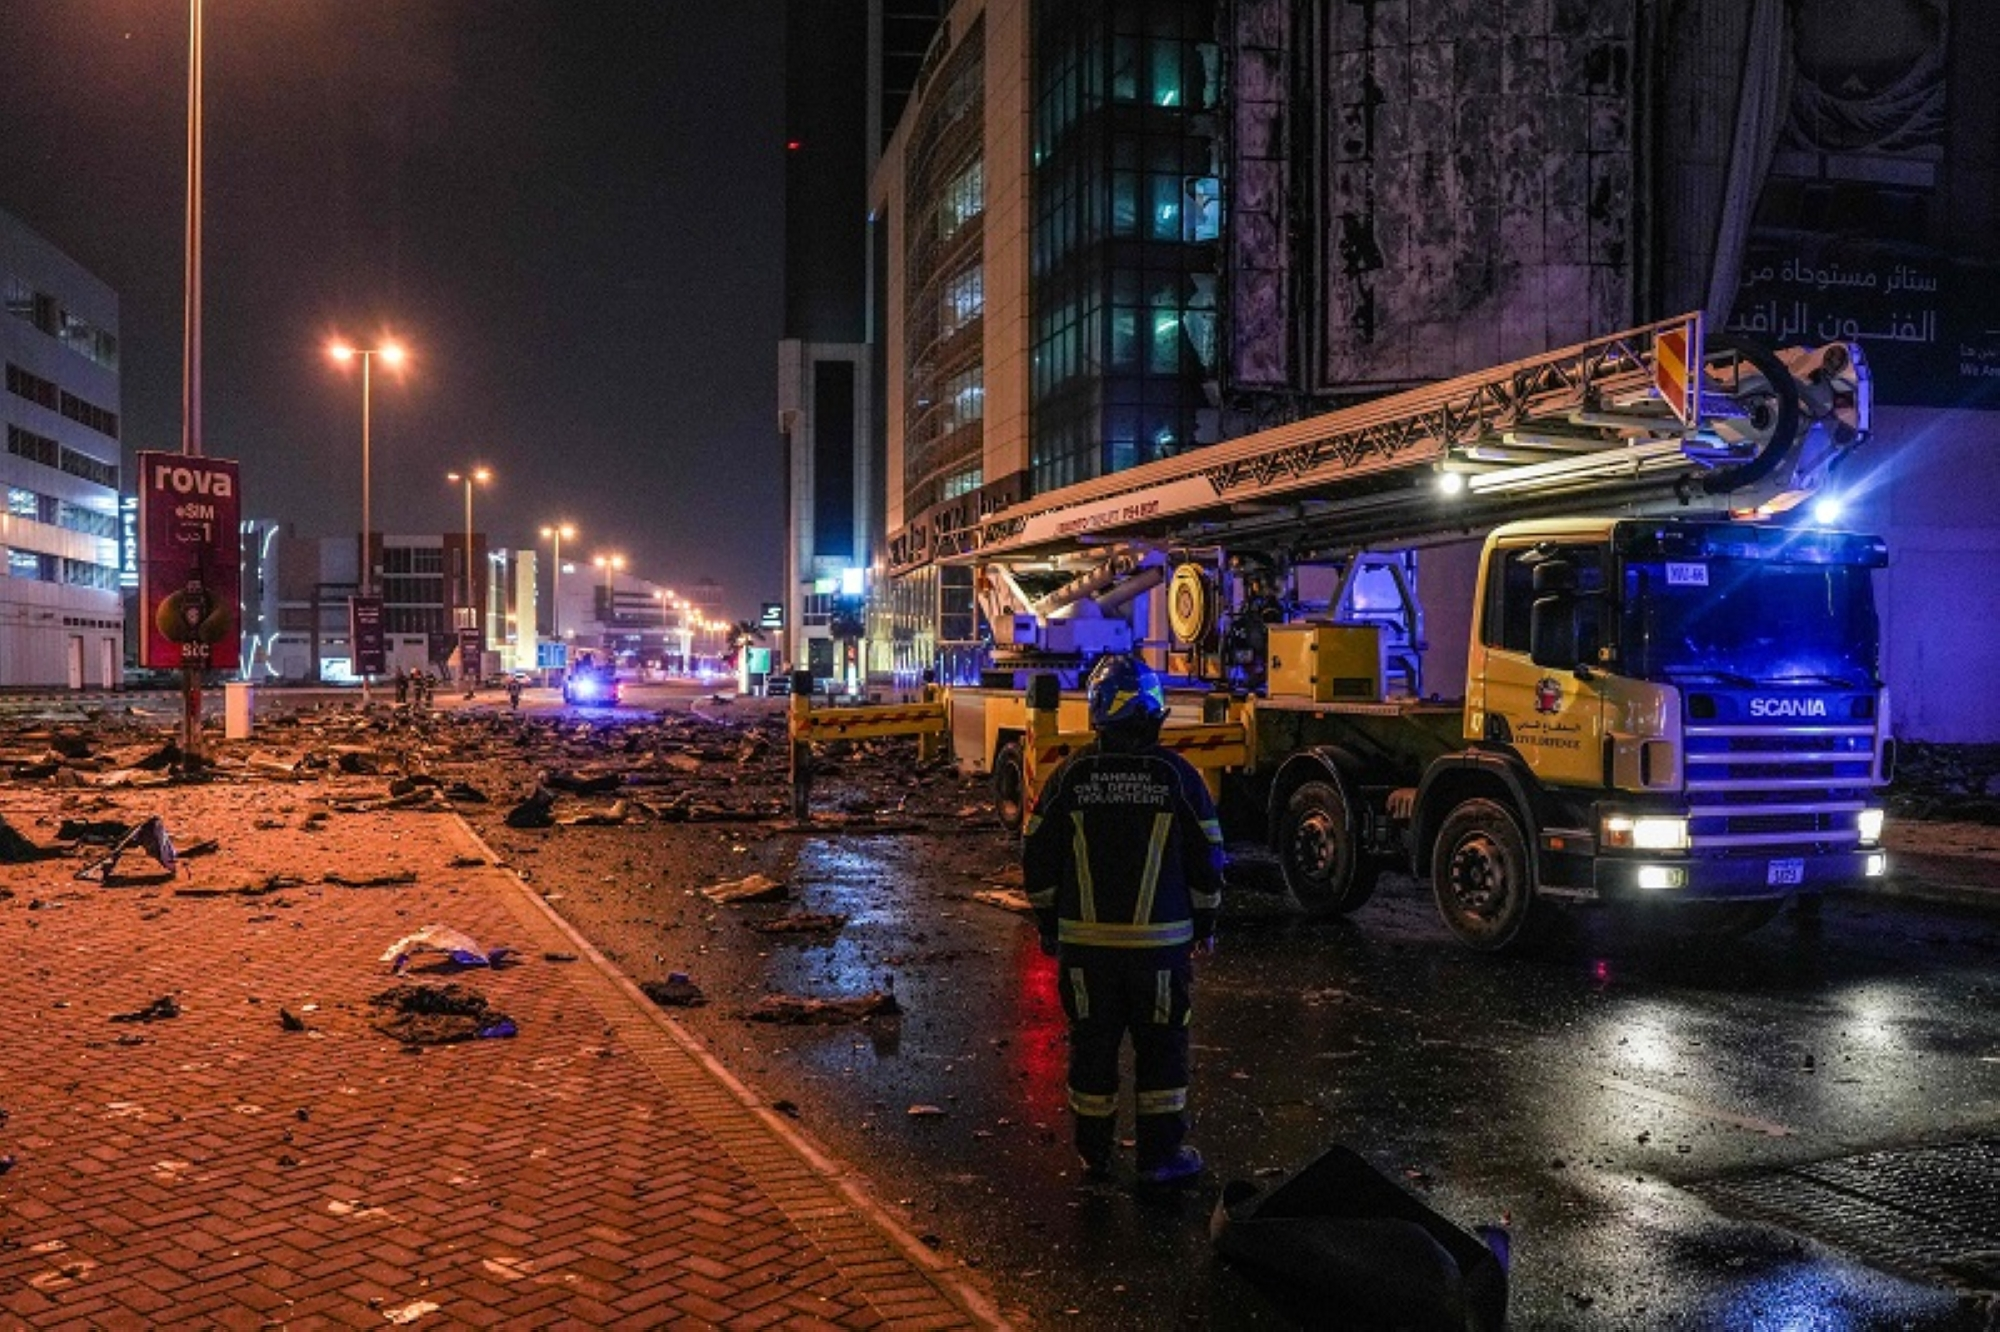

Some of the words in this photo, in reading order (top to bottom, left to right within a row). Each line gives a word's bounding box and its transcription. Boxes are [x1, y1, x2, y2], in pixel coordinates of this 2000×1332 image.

[1782, 258, 1877, 290] مستوحاة
[1884, 264, 1937, 294] ستائر
[155, 464, 232, 497] rova
[1750, 698, 1826, 716] SCANIA
[1090, 772, 1151, 782] BAHRAIN
